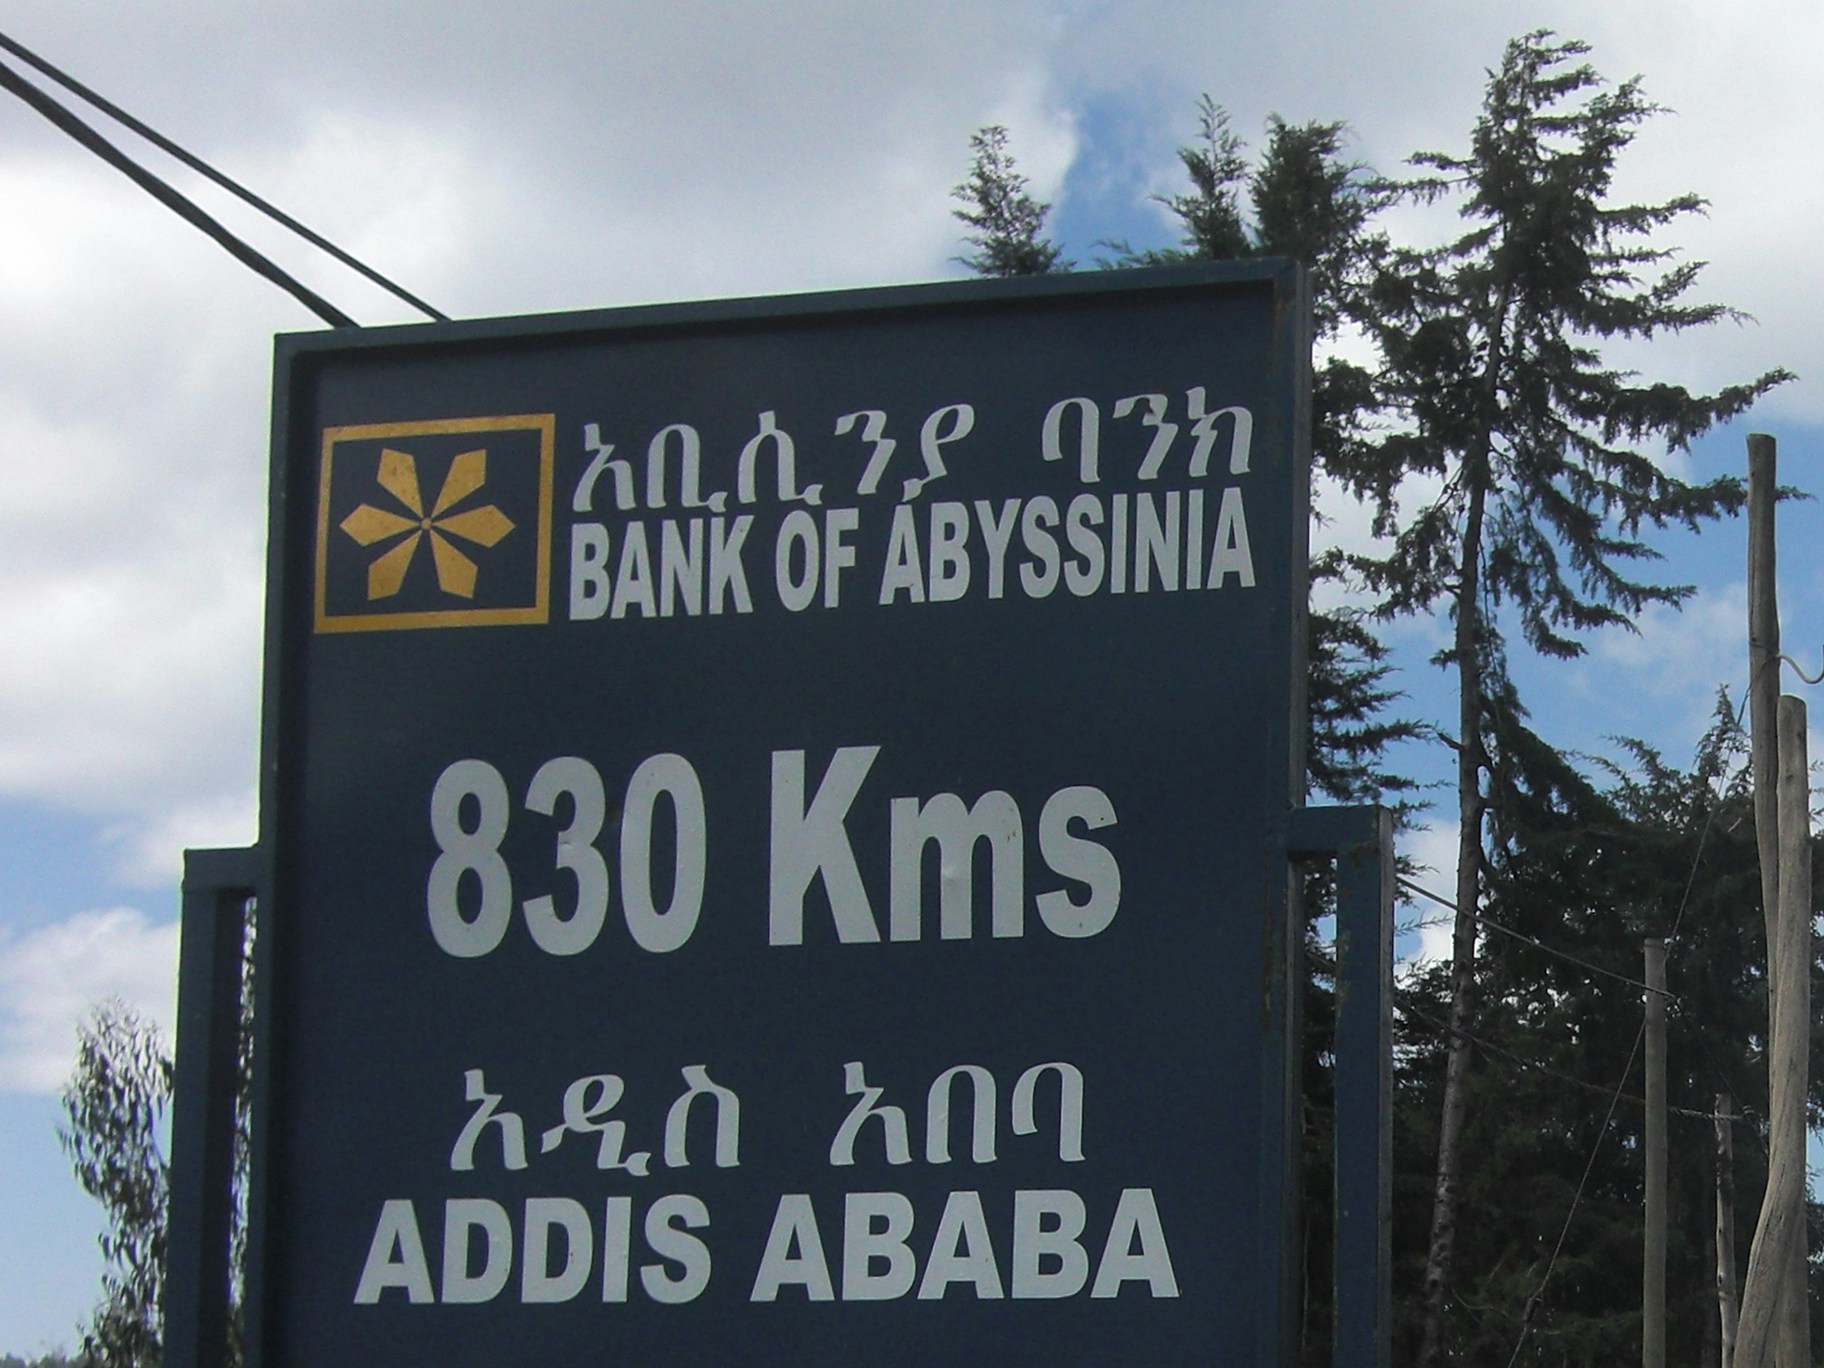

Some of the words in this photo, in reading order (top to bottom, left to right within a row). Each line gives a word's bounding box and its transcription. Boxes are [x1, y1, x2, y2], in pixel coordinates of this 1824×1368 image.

[1042, 385, 1254, 484] ባንክ
[569, 513, 755, 620] BANK
[775, 505, 860, 612] OF
[878, 485, 1257, 606] ABYSSINIA
[426, 752, 707, 958] 830
[768, 744, 1122, 947] Kms
[450, 1064, 741, 1177] አዲስ
[829, 1061, 1086, 1166] አበባ
[353, 1193, 713, 1305] ADDIS
[749, 1187, 1180, 1302] ABABA
